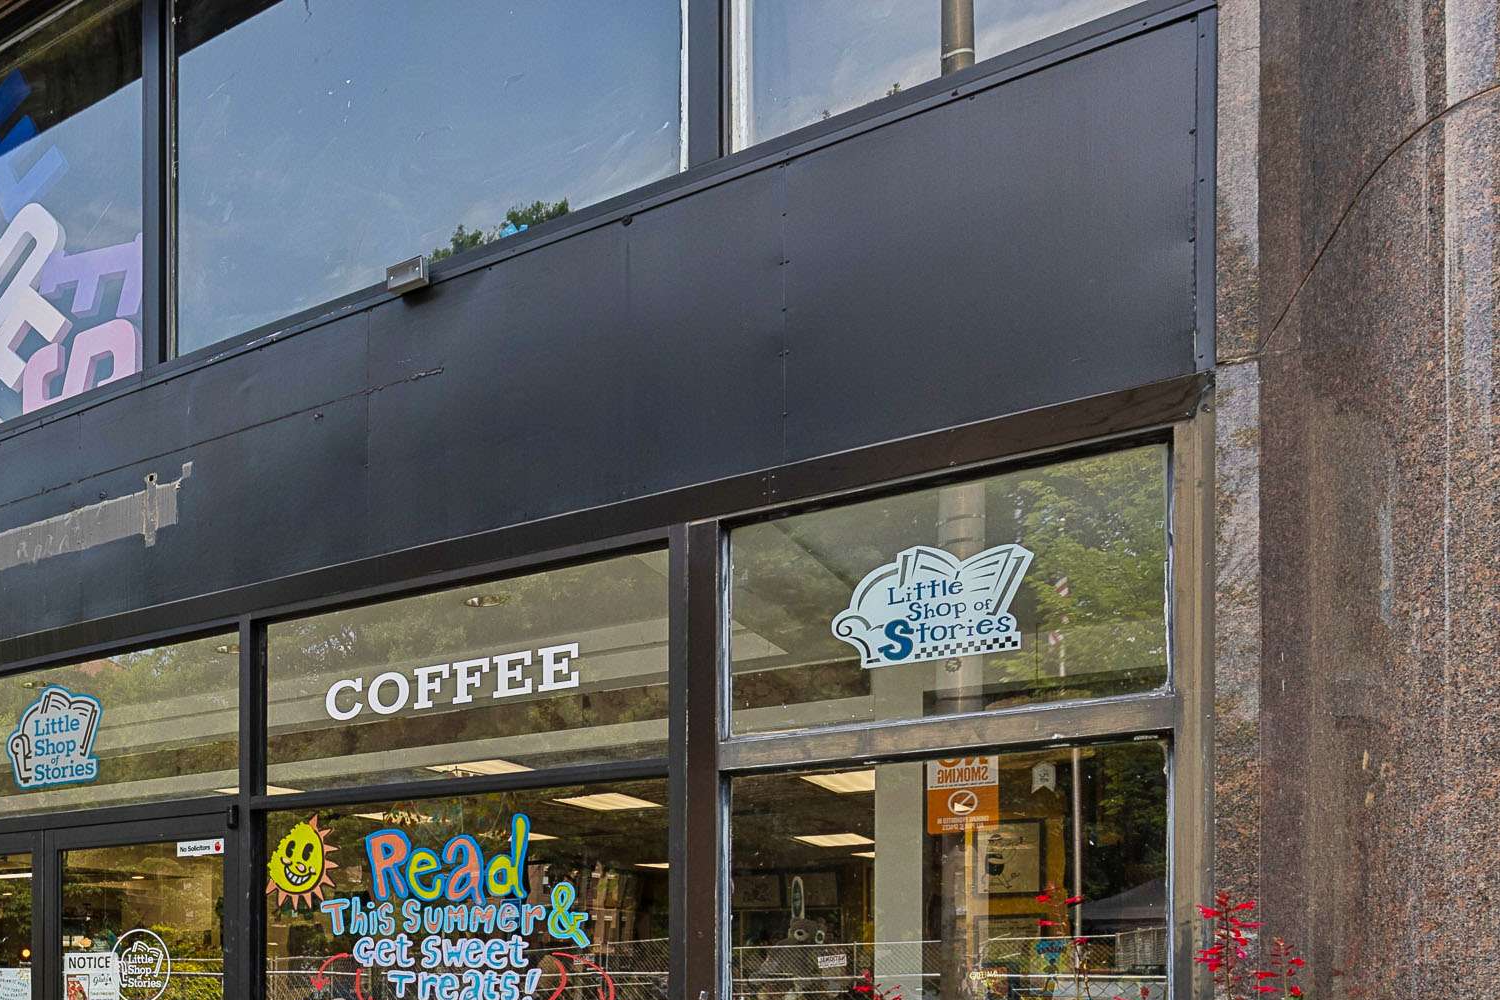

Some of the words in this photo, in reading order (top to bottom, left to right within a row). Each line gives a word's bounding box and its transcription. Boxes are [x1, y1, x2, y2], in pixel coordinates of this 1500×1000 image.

[888, 579, 963, 605] Little
[906, 601, 966, 621] Shop
[974, 598, 993, 611] of
[878, 616, 1011, 661] Stories
[325, 643, 580, 721] COFFEE
[34, 714, 80, 736] Little
[35, 739, 76, 757] Shop
[35, 760, 94, 781] Stories
[51, 756, 59, 765] of
[365, 813, 532, 904] Read
[321, 897, 396, 936] This
[548, 881, 591, 948] &
[68, 956, 111, 969] NOTICE
[127, 954, 154, 964] Little
[127, 965, 151, 976] Shop
[127, 978, 162, 988] Stories
